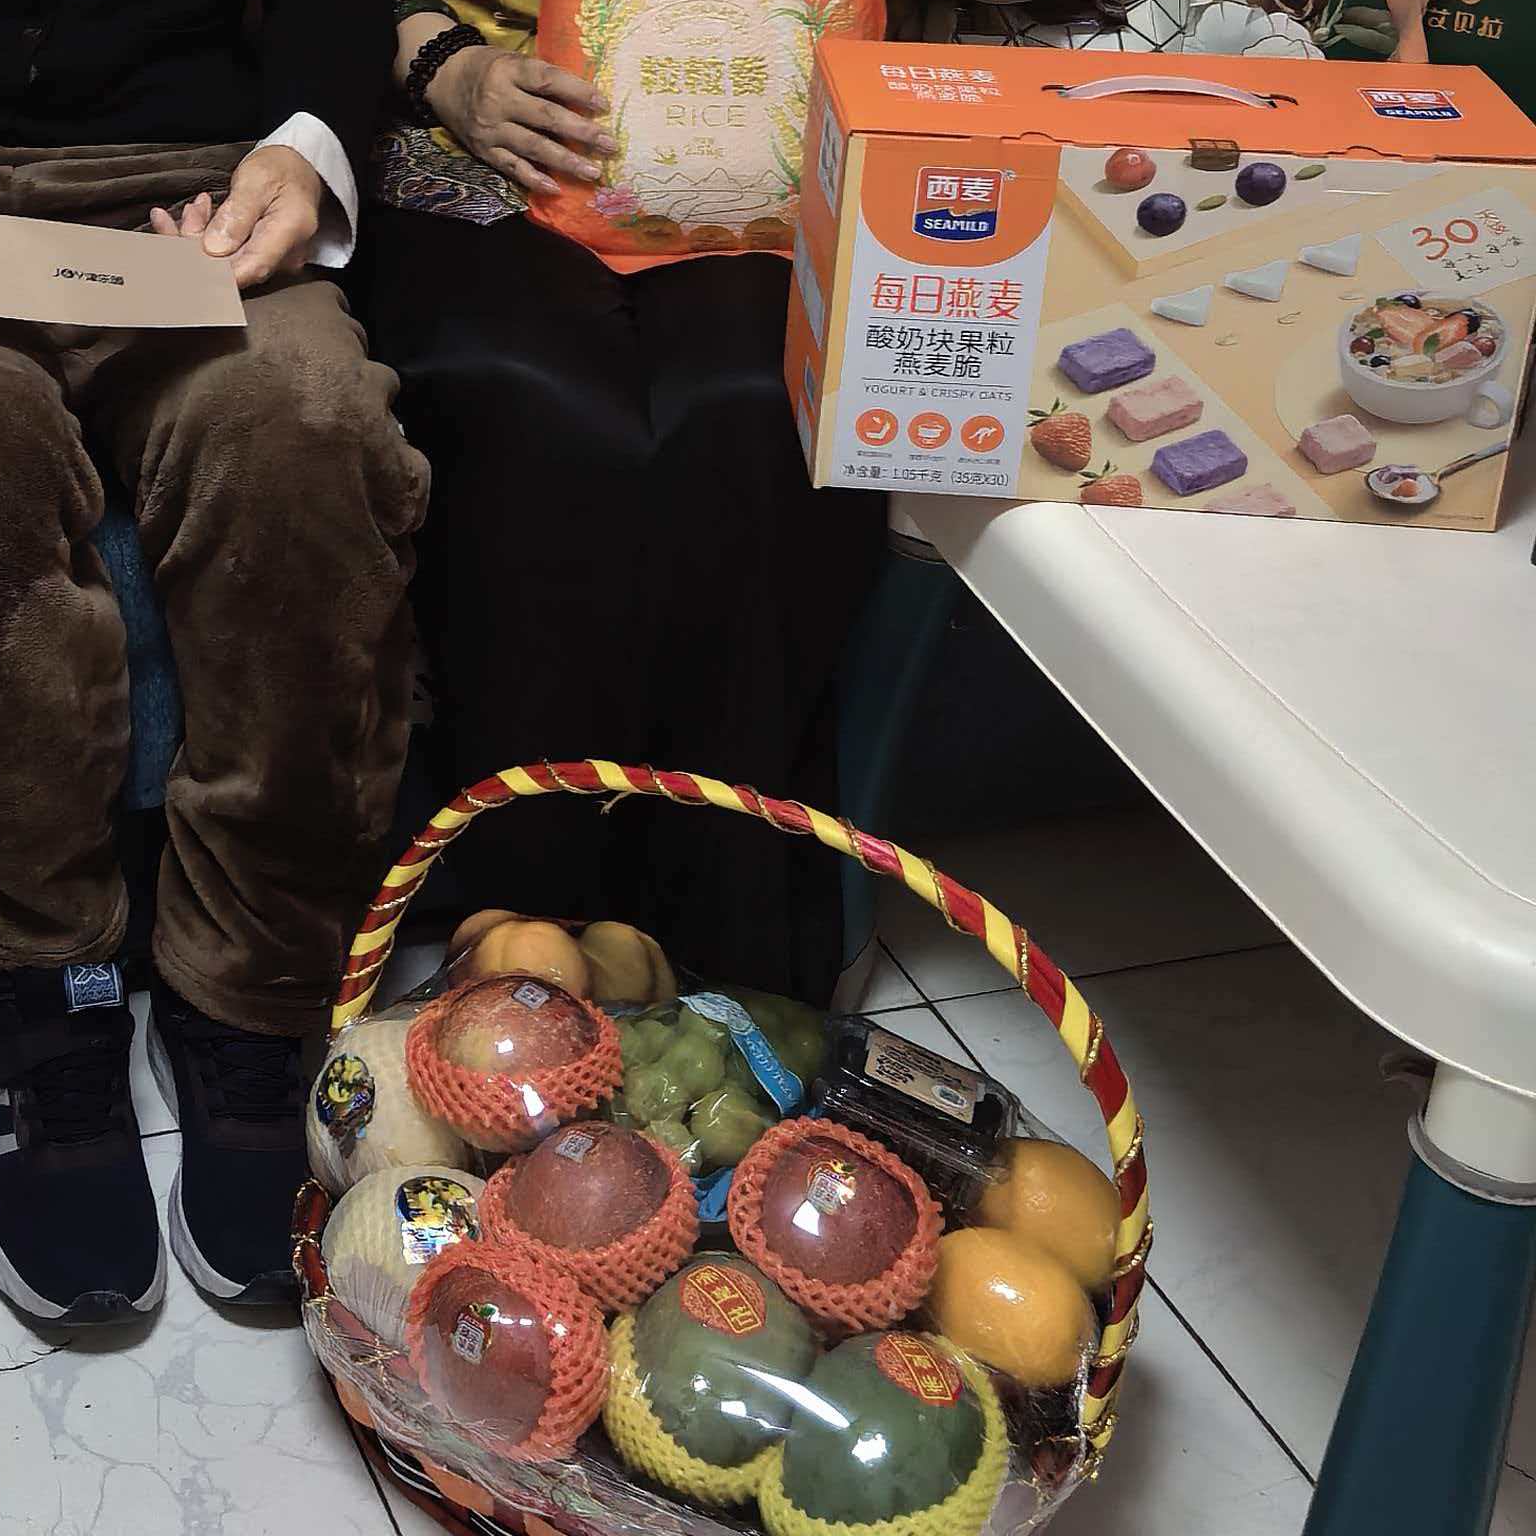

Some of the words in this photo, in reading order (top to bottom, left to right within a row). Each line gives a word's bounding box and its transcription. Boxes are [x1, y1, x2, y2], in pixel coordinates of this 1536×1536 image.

[666, 104, 747, 127] RICE
[926, 175, 995, 202] 西麦
[924, 217, 989, 232] SEAMILD
[1412, 218, 1479, 261] 30
[870, 272, 1024, 321] 每日燕麦
[866, 325, 1015, 356] 酸奶块果粒
[894, 353, 982, 379] 燕麦脆
[864, 385, 914, 398] YOGURT
